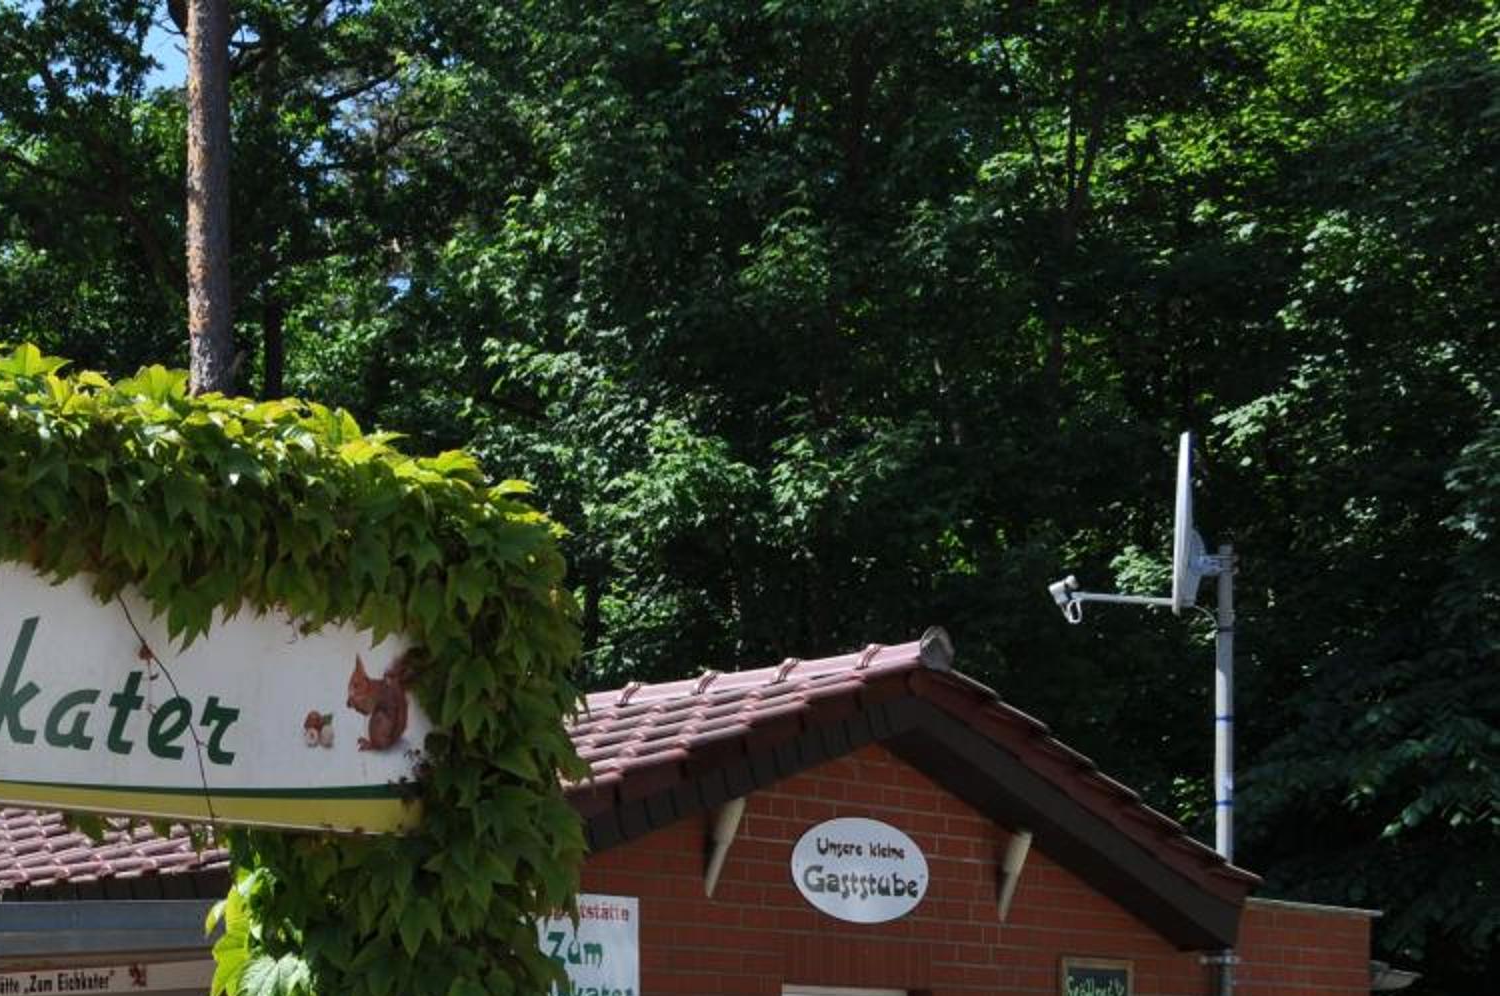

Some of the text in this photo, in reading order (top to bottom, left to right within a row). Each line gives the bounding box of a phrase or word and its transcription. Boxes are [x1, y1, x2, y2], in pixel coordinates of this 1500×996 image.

[816, 837, 906, 860] Unsere kleine
[803, 864, 919, 900] Gaststube
[547, 931, 603, 967] Zum
